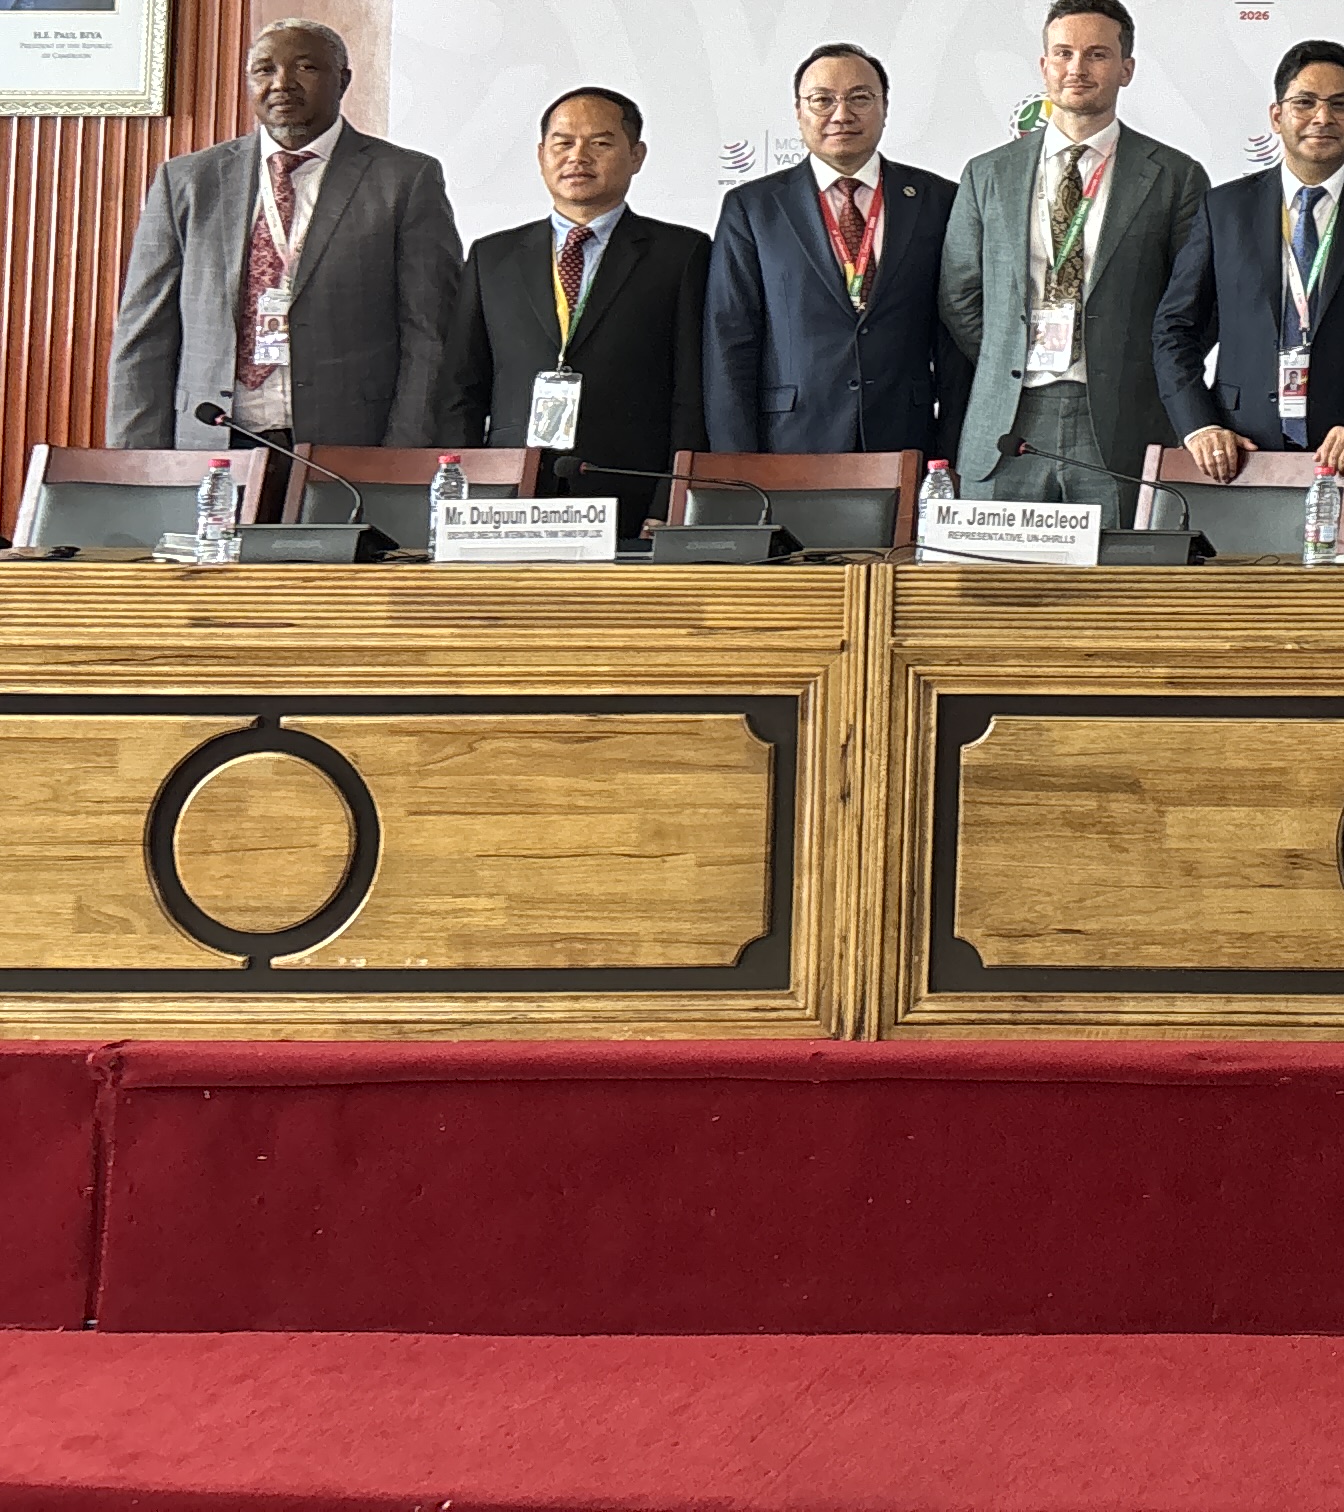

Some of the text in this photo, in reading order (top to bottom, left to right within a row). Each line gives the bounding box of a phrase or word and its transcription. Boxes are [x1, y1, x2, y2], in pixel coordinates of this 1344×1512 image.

[1240, 11, 1269, 20] 2026
[776, 138, 805, 149] MC1
[445, 505, 606, 529] Mr. Dulguun Damdin-Od
[937, 506, 1090, 529] Mr. Jamie Macleod
